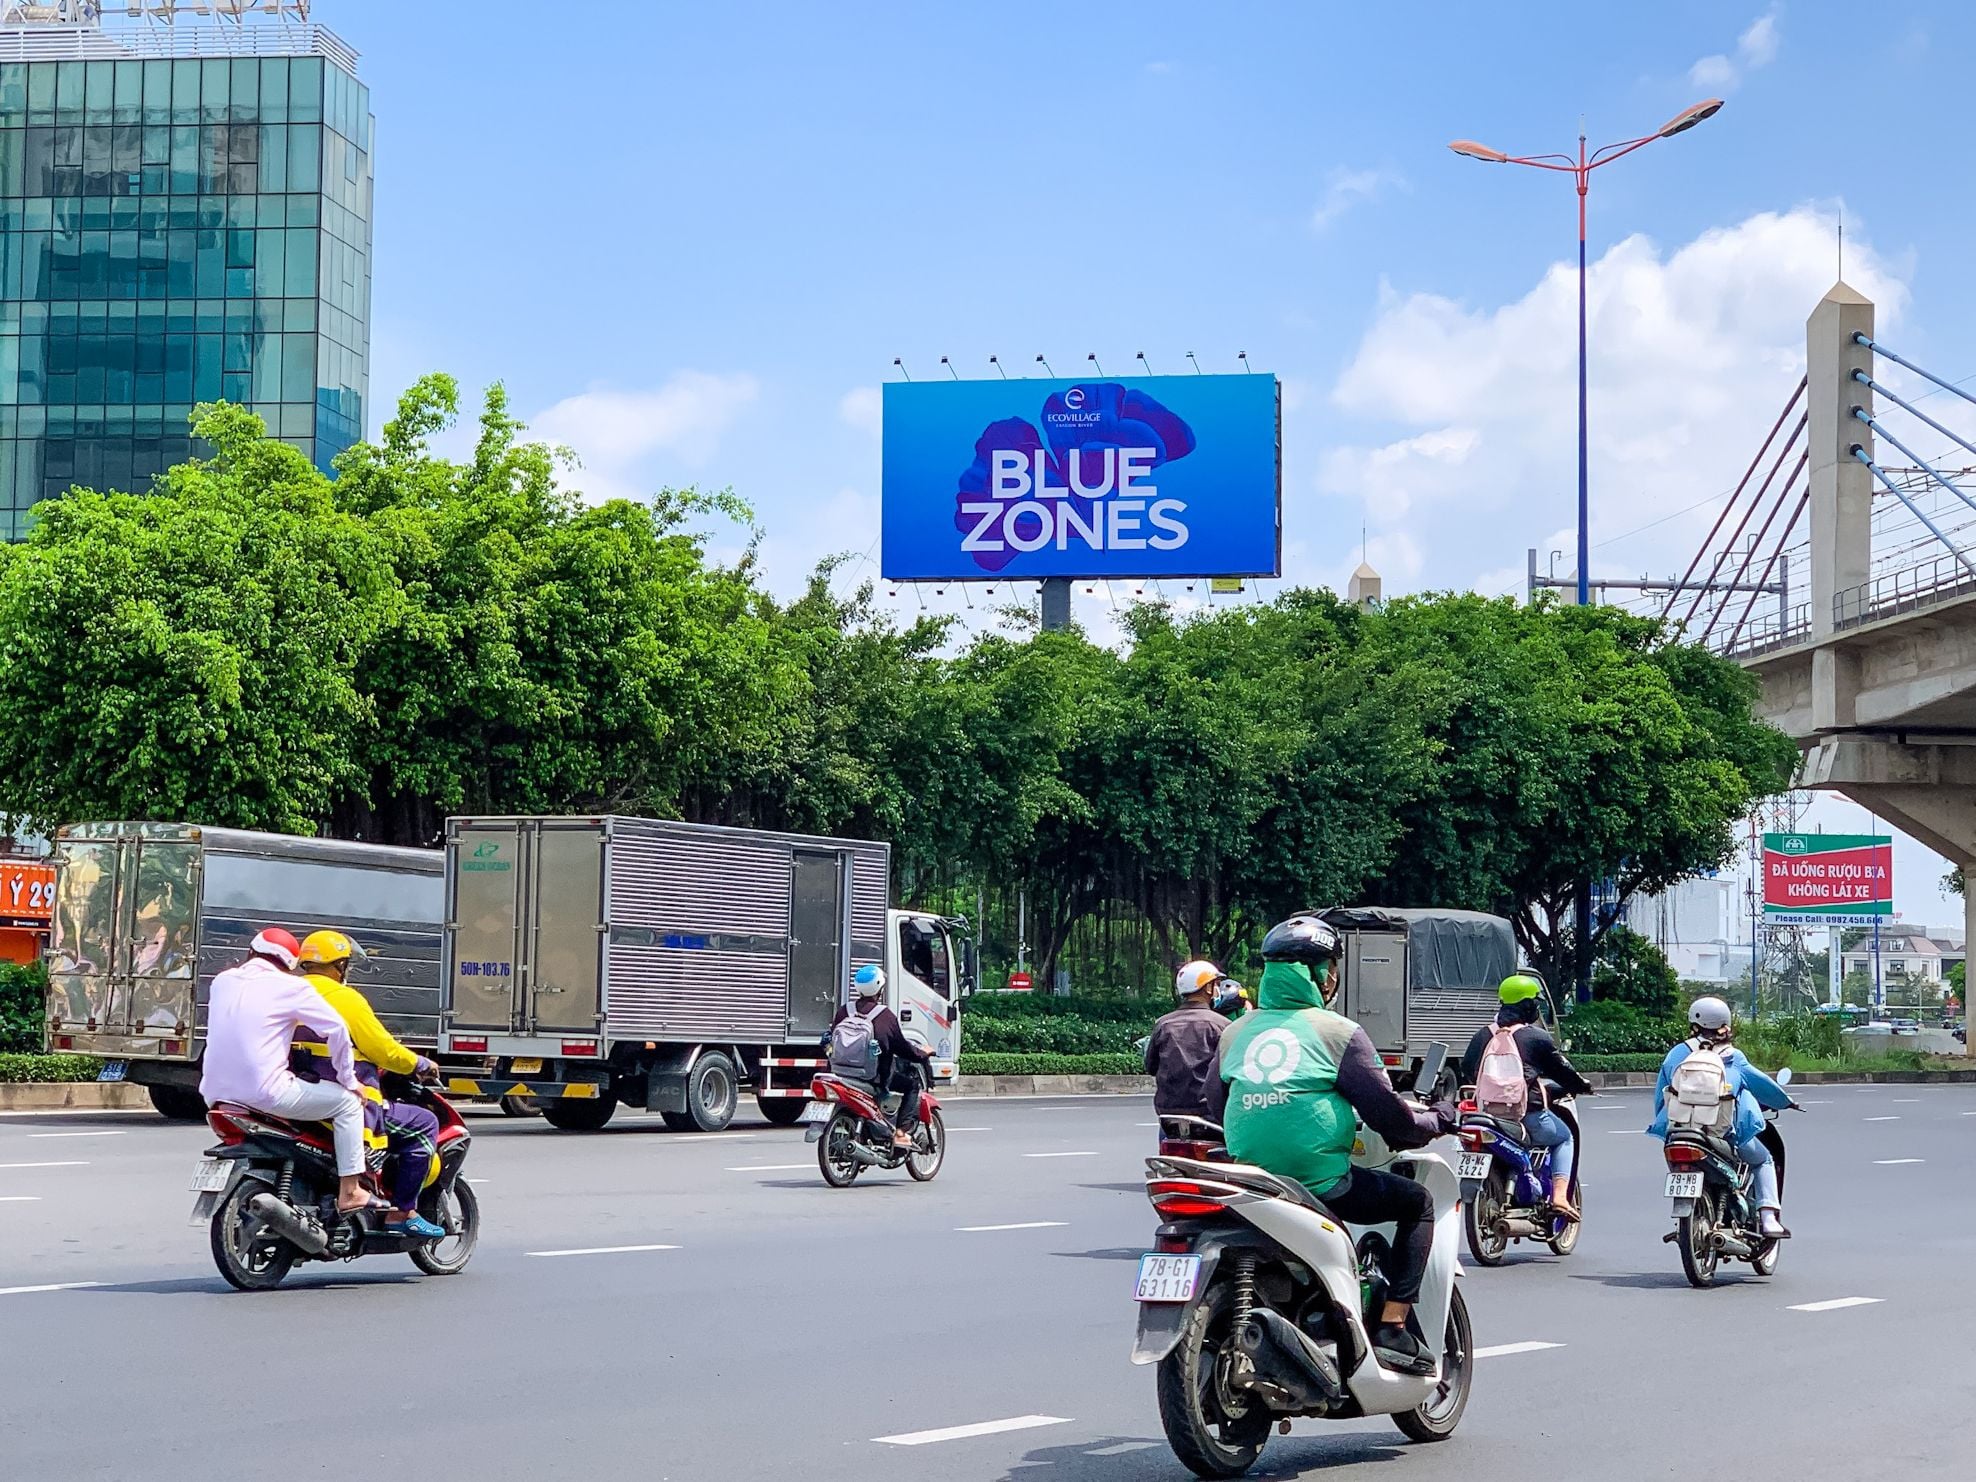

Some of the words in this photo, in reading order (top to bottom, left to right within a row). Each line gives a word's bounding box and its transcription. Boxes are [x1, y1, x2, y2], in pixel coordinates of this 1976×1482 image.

[1047, 413, 1101, 422] ECOVILLAGE
[991, 447, 1158, 499] BLUE
[961, 499, 1189, 552] ZONES
[1772, 861, 1789, 877] ĐÃ
[1828, 863, 1861, 881] RƯỢU
[10, 872, 24, 906] Ý
[1788, 880, 1830, 897] KHÔNG
[1832, 881, 1852, 898] LÁI
[1854, 885, 1870, 898] XE
[1775, 914, 1803, 923] Please
[1242, 1089, 1292, 1110] gojek
[1669, 1185, 1697, 1196] 8079
[1138, 1279, 1192, 1298] 631.16
